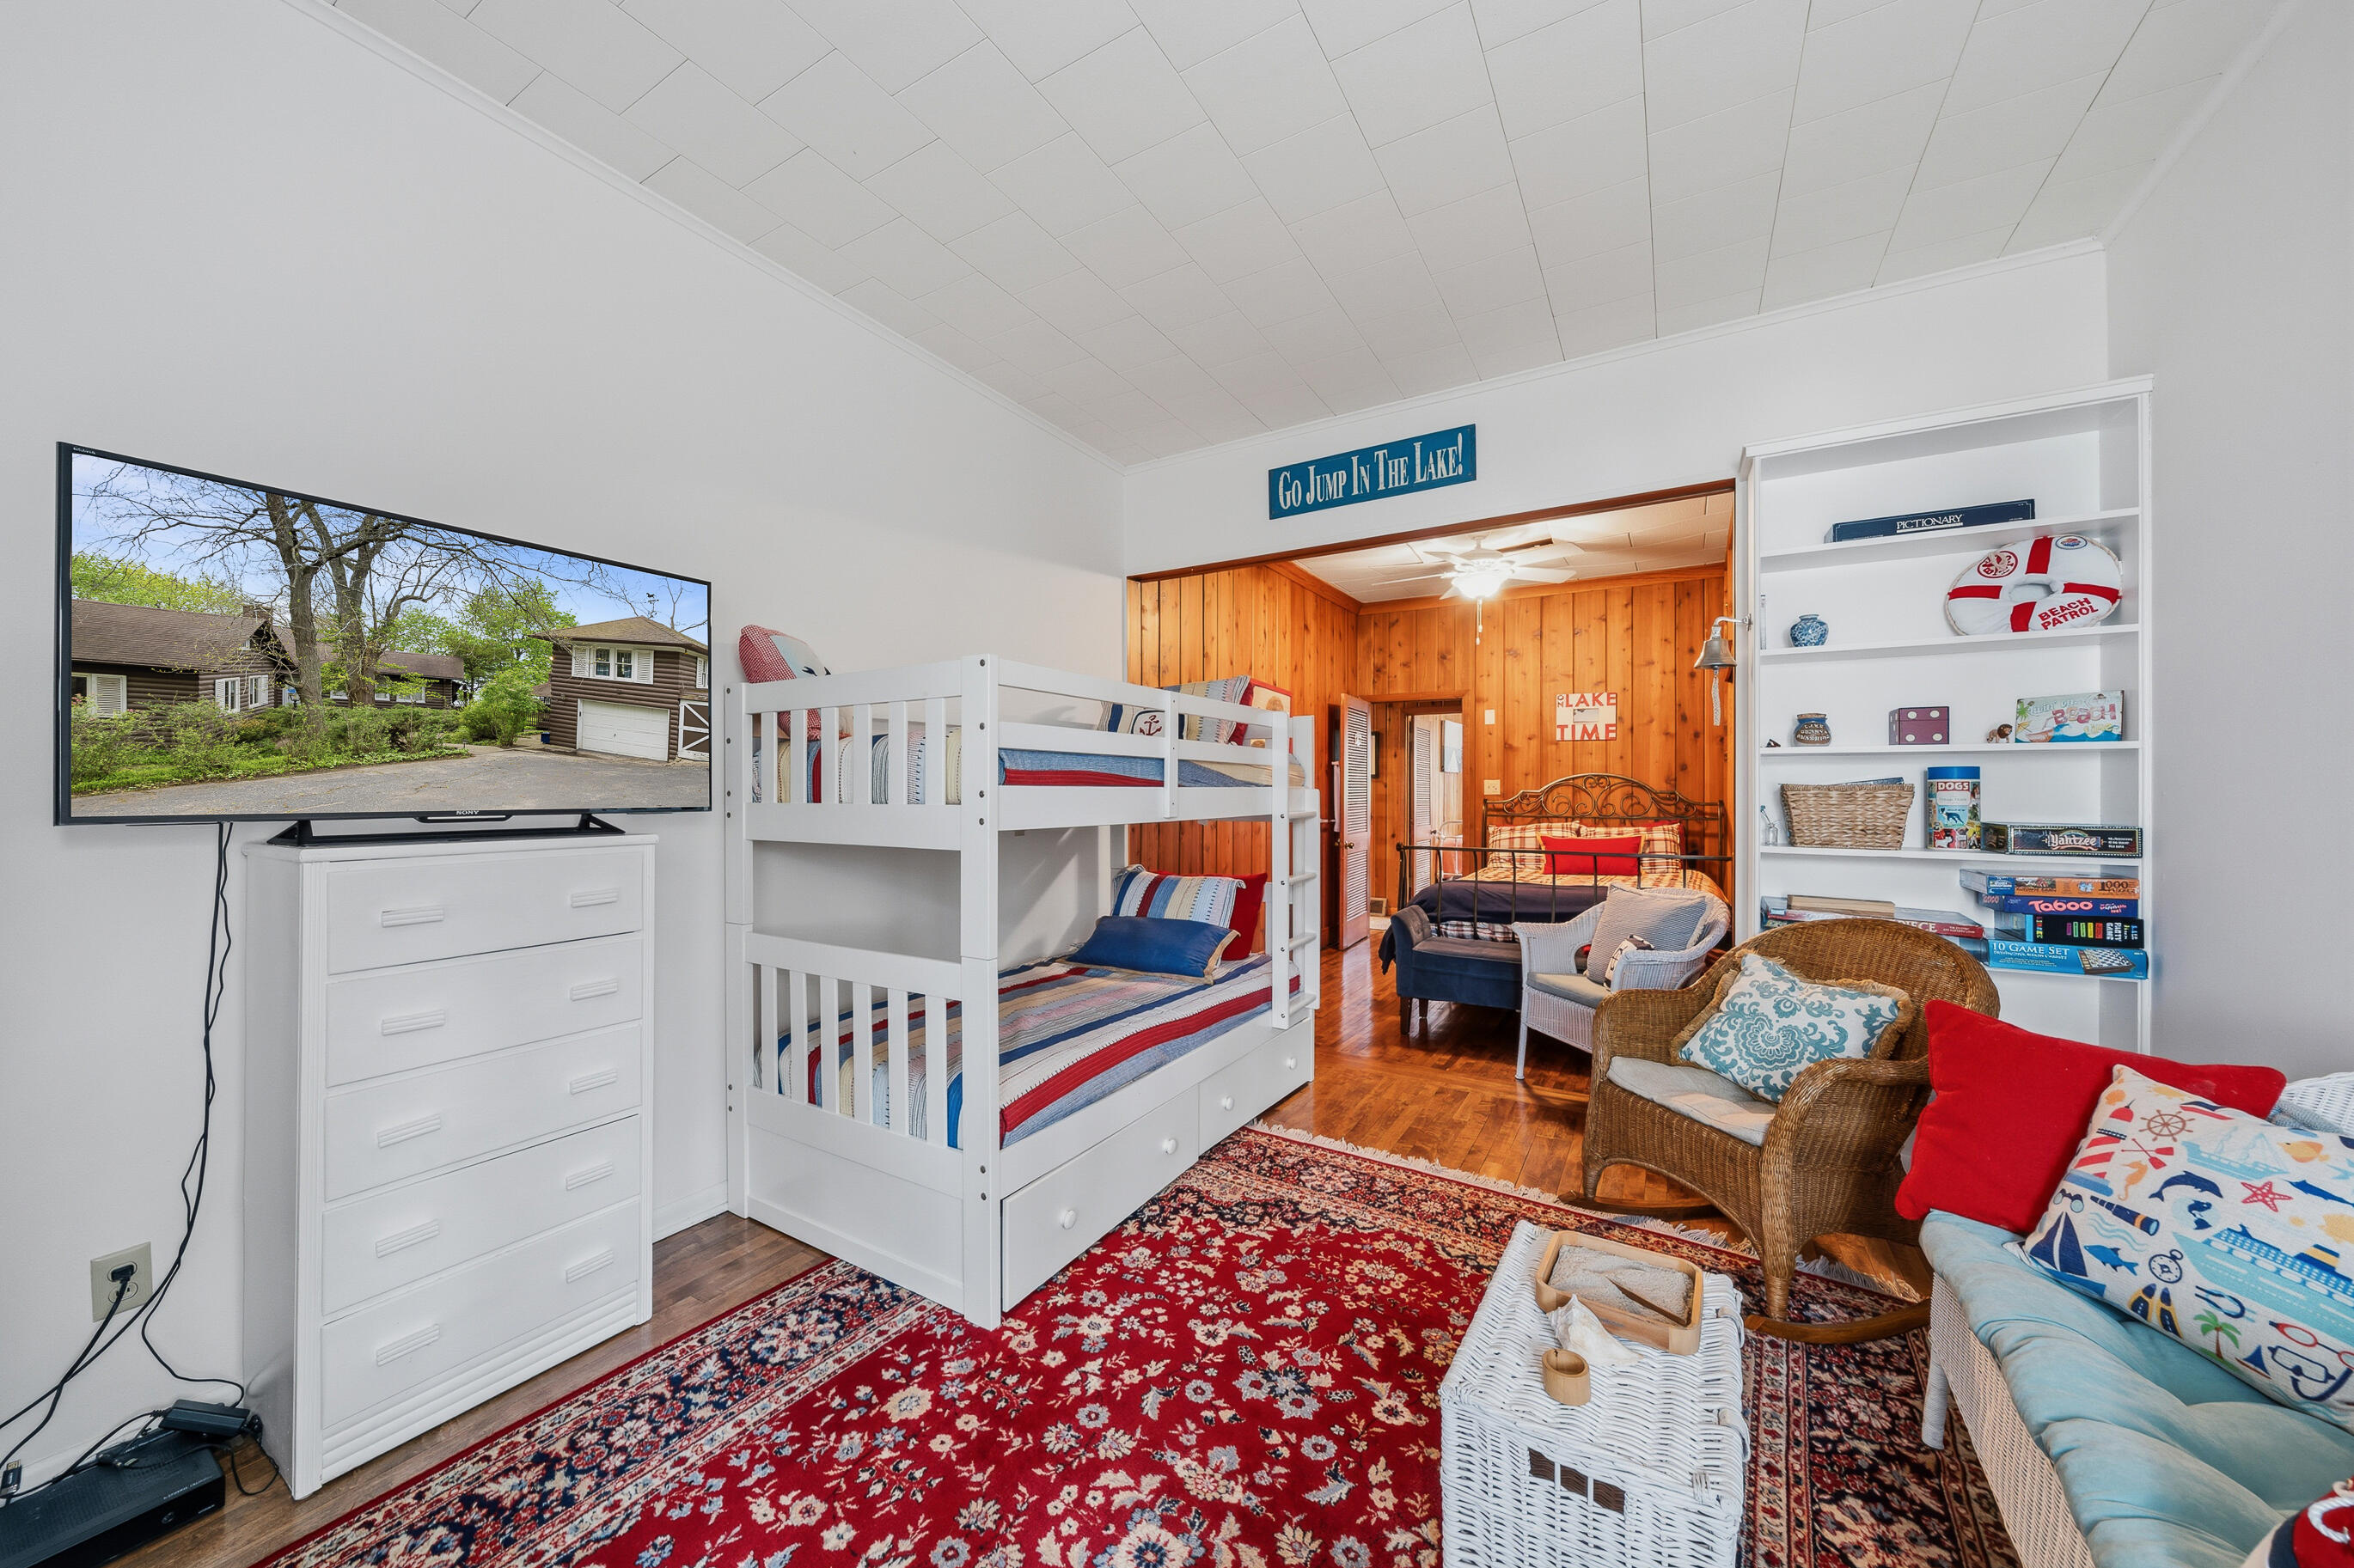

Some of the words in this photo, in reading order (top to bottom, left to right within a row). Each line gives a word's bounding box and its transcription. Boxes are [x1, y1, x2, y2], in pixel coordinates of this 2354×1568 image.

[1278, 470, 1302, 509] GO
[1305, 465, 1347, 505] JUMP
[1351, 455, 1370, 496] IN
[1374, 448, 1409, 491] THE
[1413, 432, 1463, 484] LAKE!
[1896, 514, 1963, 530] PICTIONARY
[2037, 597, 2092, 621] BEACH
[2041, 605, 2099, 631] PATROL
[1565, 692, 1617, 707] LAKE
[2051, 703, 2117, 725] BEACH
[1556, 723, 1617, 741] TIME
[1937, 782, 1969, 790] DOGS
[2050, 833, 2097, 846] Yahtzee
[2098, 881, 2129, 892] 1000
[2028, 899, 2093, 913] Taboo
[1993, 942, 2006, 950] 10
[2009, 943, 2045, 954] GAME
[2048, 946, 2070, 955] SET
